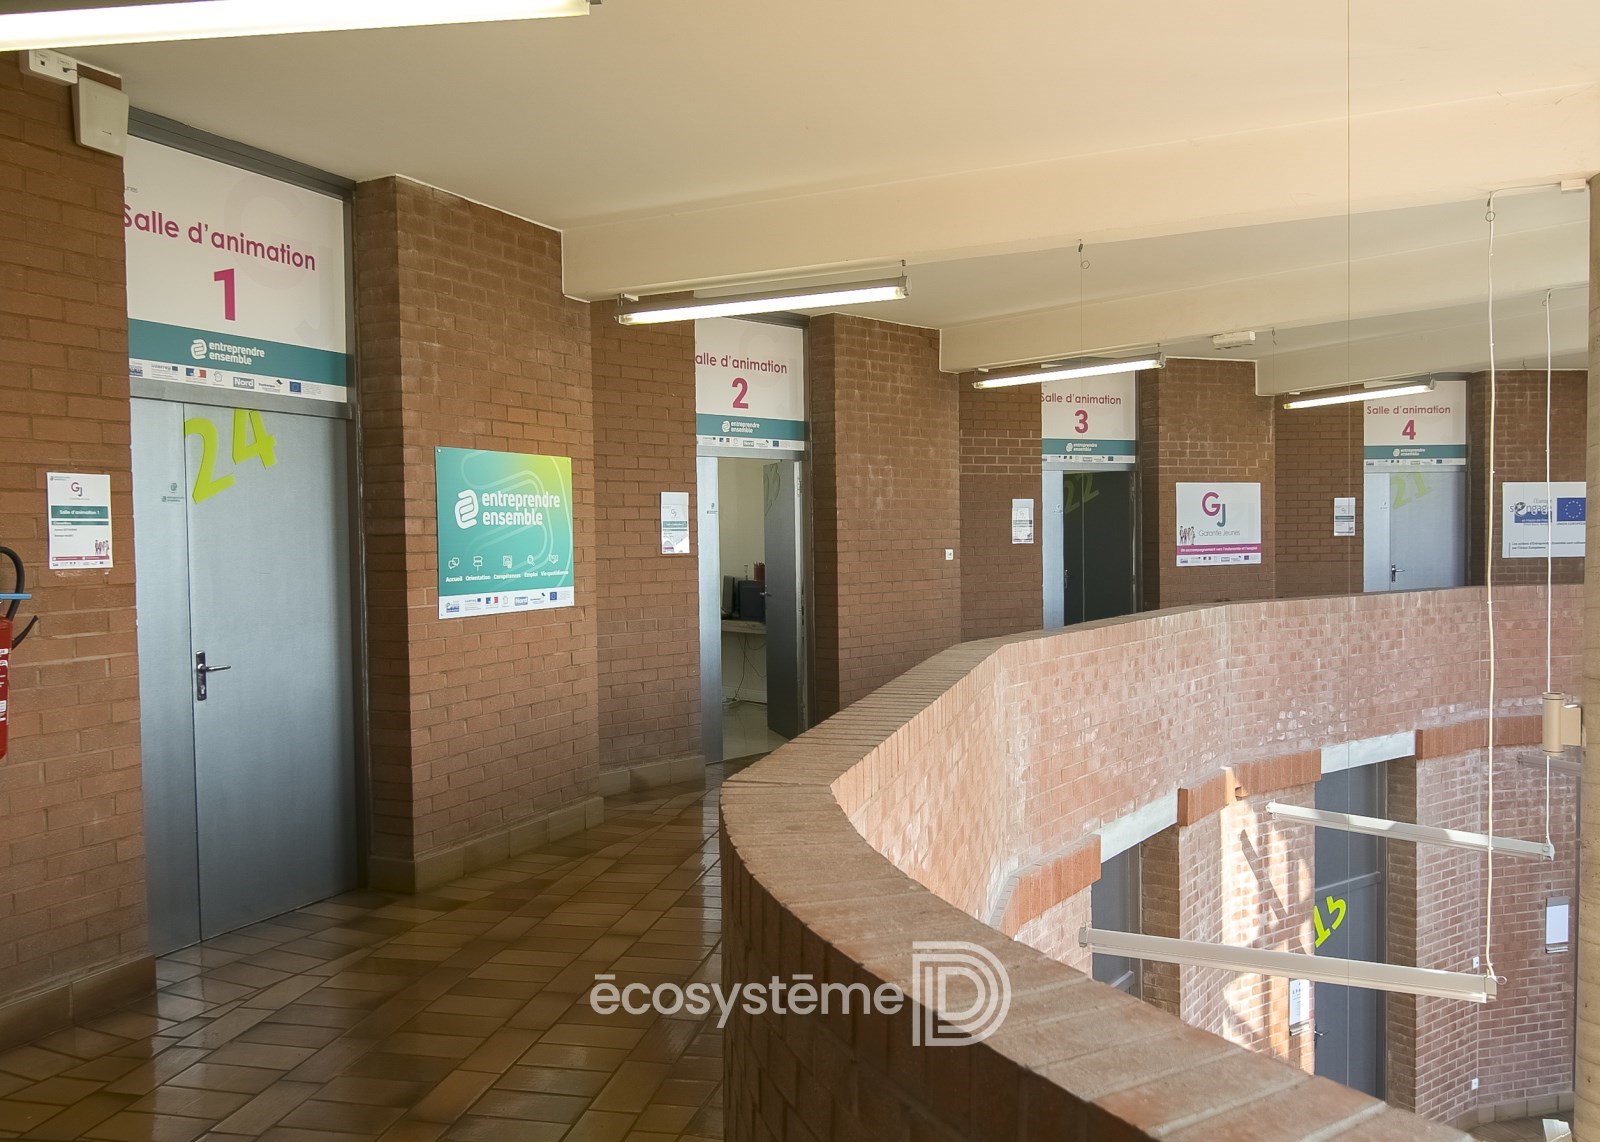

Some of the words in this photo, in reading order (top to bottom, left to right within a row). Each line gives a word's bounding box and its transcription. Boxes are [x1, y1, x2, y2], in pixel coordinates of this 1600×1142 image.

[124, 204, 179, 238] Salle
[188, 222, 316, 271] d'animation
[213, 268, 236, 321] 1
[208, 341, 265, 358] entreprendre
[208, 351, 252, 366] ensemble
[695, 352, 717, 366] alle
[720, 355, 787, 374] d'animation
[234, 377, 254, 387] Nord
[731, 377, 749, 409] 2
[1066, 394, 1122, 405] d'animation
[1366, 405, 1390, 415] Salle
[1393, 405, 1451, 414] d'animation
[730, 421, 760, 429] entreprendre
[1074, 409, 1089, 433] 3
[1401, 419, 1417, 440] 4
[183, 407, 277, 505] 24
[70, 481, 83, 497] GJ
[481, 490, 561, 511] entreprendre
[1201, 491, 1226, 528] GJ
[482, 508, 543, 526] ensemble
[445, 575, 463, 583] Accueil
[465, 574, 491, 582] Orientation
[1313, 896, 1347, 949] 15
